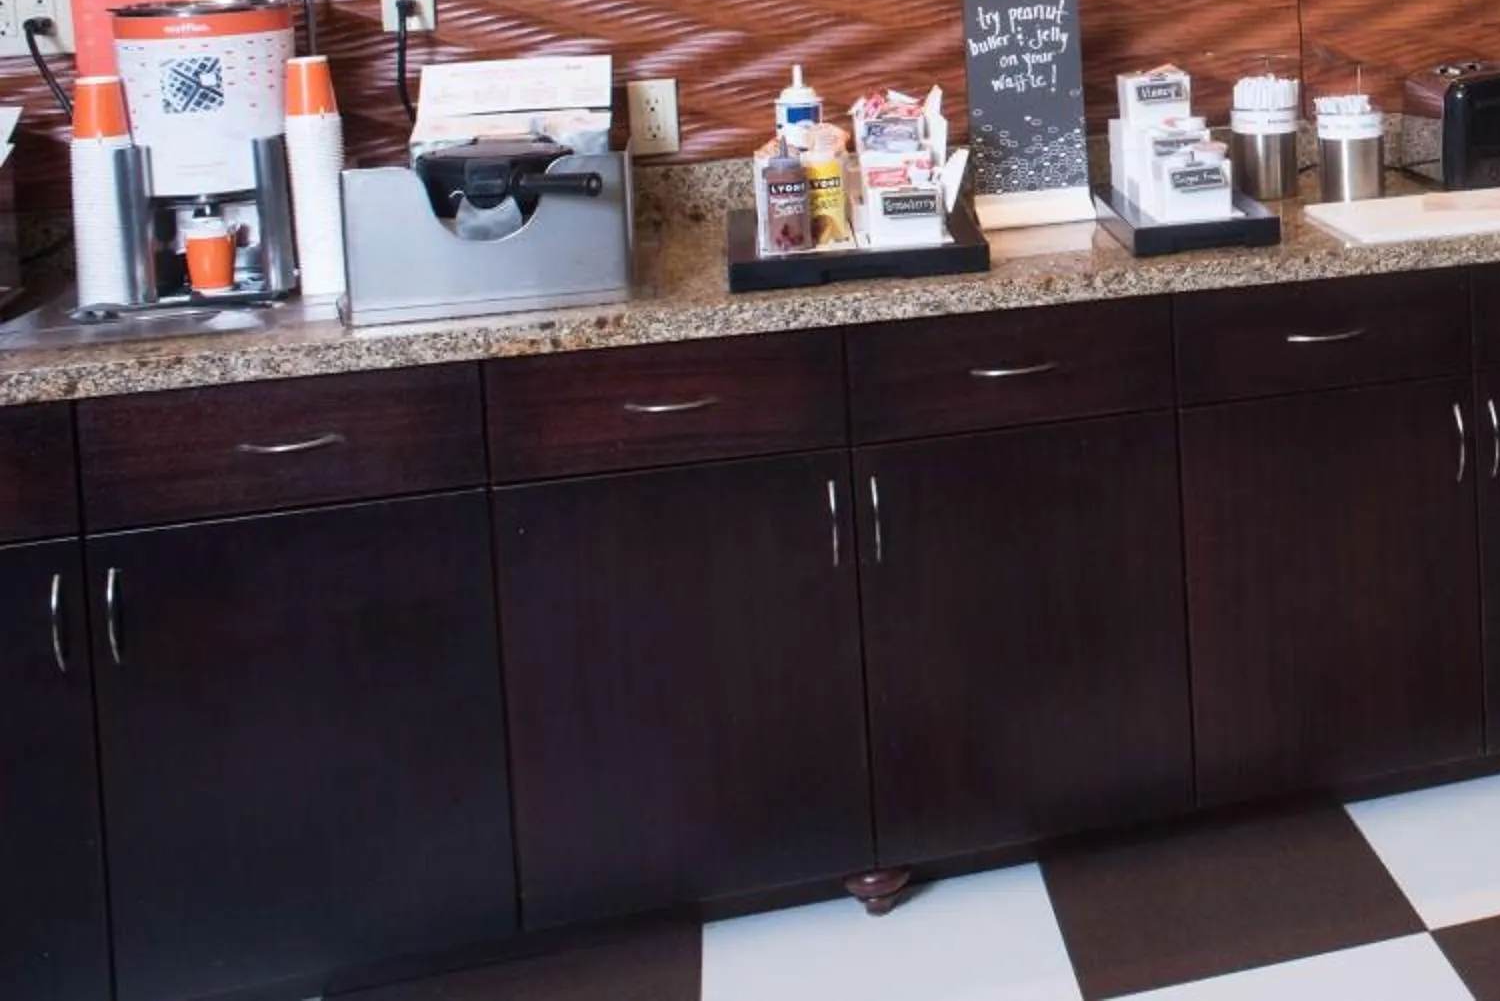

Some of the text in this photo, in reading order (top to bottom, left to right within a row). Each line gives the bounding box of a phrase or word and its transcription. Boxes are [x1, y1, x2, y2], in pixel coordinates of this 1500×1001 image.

[976, 6, 1000, 36] try
[967, 33, 1010, 57] butter
[1029, 24, 1069, 53] jelly
[1000, 51, 1057, 76] on your
